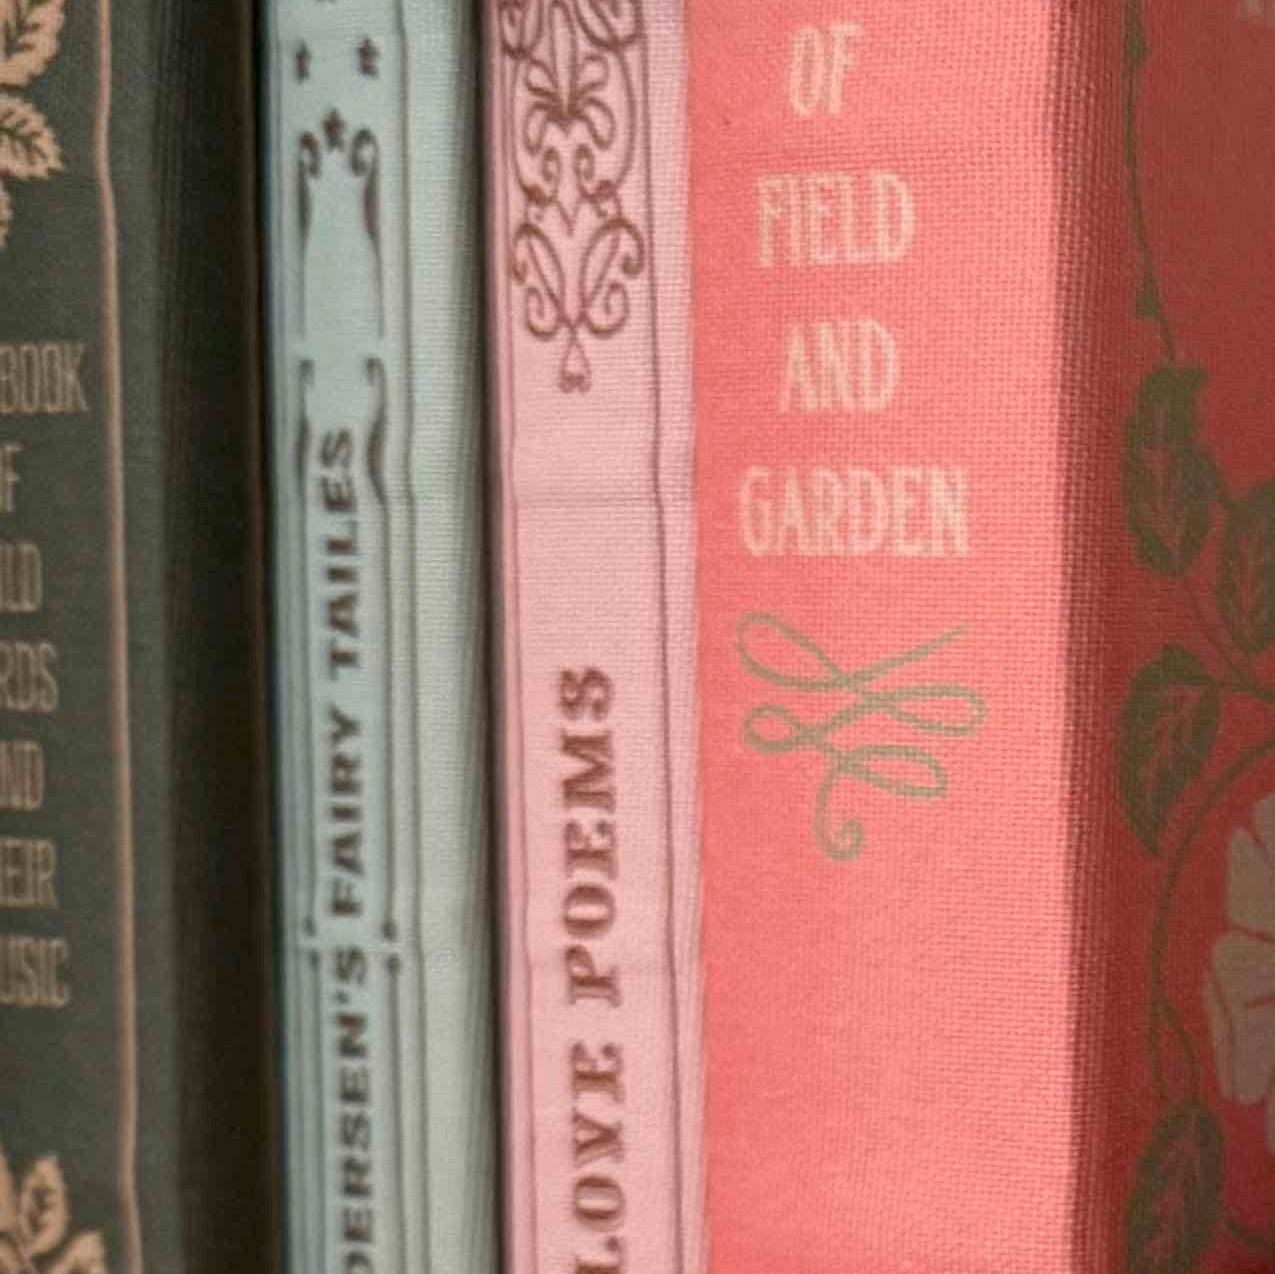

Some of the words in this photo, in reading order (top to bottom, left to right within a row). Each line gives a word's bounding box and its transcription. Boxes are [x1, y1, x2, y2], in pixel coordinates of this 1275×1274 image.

[788, 21, 865, 116] OF
[754, 169, 916, 270] FIELD
[779, 318, 897, 413] AND
[0, 444, 22, 512] F
[736, 465, 970, 558] GARDEN
[329, 706, 366, 917] FAIRY
[558, 667, 621, 1007] POEMS
